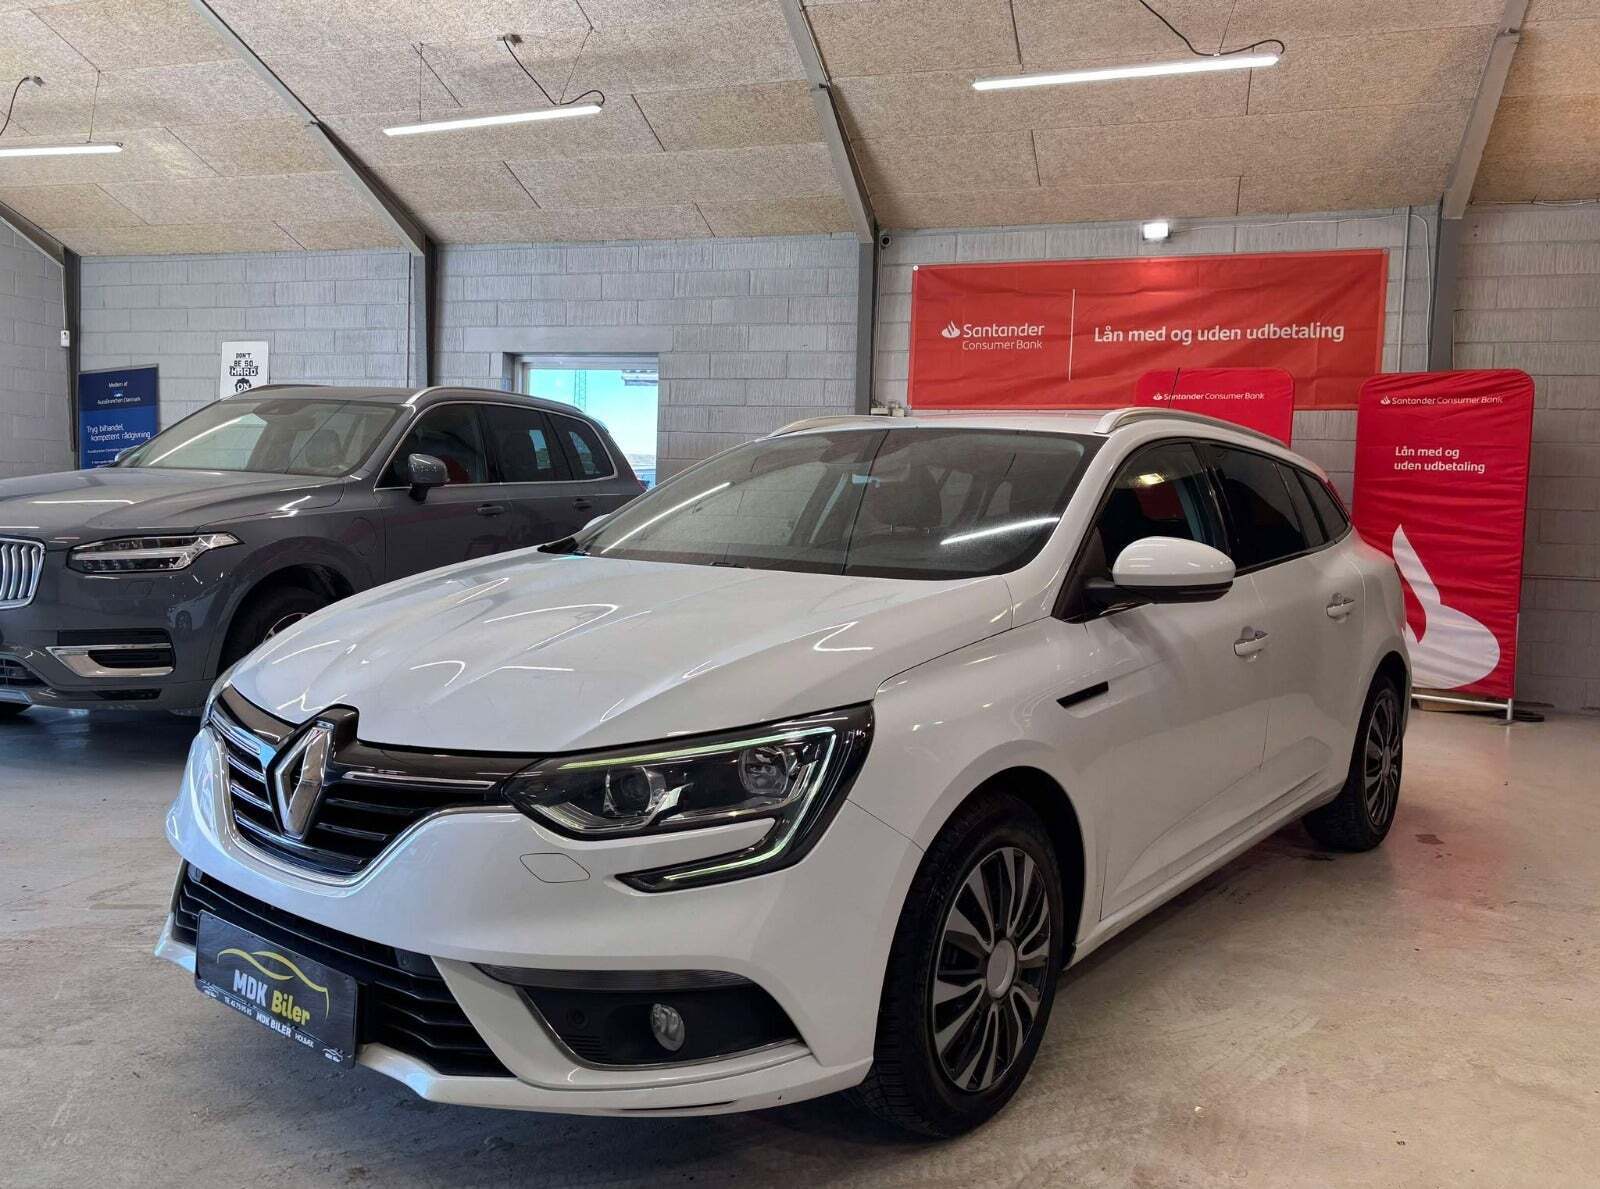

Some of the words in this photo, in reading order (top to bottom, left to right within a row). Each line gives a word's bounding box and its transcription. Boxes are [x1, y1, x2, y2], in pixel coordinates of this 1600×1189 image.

[963, 323, 1045, 338] Santander
[1094, 325, 1123, 342] Lån
[1128, 326, 1166, 342] med
[1170, 329, 1193, 345] og
[1198, 325, 1241, 341] uden
[1247, 322, 1345, 343] udbetaling
[962, 340, 1015, 350] Consumer
[1016, 340, 1042, 349] Bank
[1245, 392, 1264, 400] Bank
[1392, 397, 1436, 405] Santander
[1437, 396, 1480, 405] Consumer
[1481, 395, 1503, 404] Bank
[1395, 446, 1415, 457] Lån
[1417, 447, 1442, 457] med
[1444, 449, 1460, 459] og
[1394, 461, 1422, 471] uden
[1424, 461, 1485, 474] udbetaling
[233, 969, 268, 1007] MDK
[271, 990, 310, 1026] Biler
[256, 1012, 271, 1026] MDK
[270, 1019, 291, 1038] BILER
